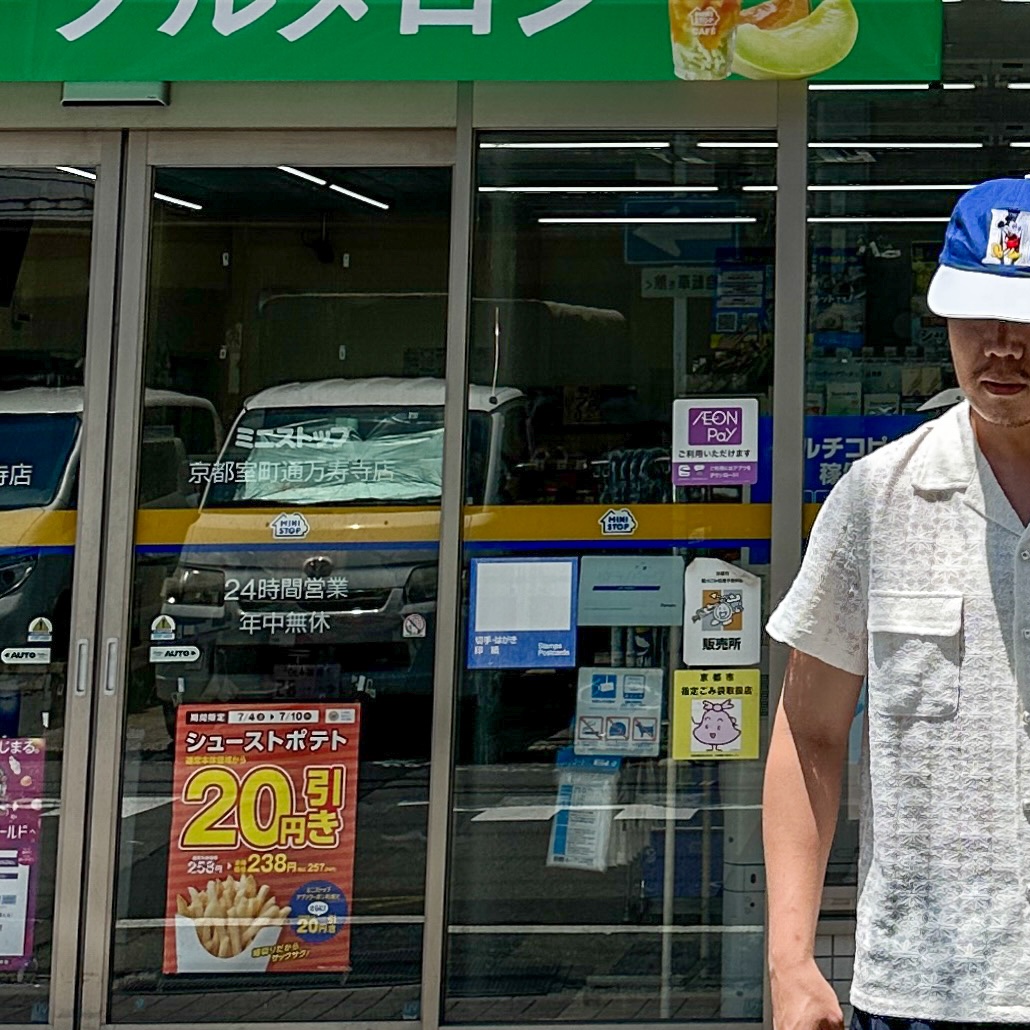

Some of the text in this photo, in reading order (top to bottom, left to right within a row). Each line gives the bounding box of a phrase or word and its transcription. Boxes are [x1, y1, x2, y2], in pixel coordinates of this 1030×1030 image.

[235, 426, 350, 448] ミニストップ
[678, 449, 751, 458] ご利用いただけます
[188, 461, 394, 484] 京都室町通万寿寺店
[608, 516, 628, 524] MINI
[279, 527, 301, 535] STOP
[224, 577, 349, 600] 24時間営業
[239, 611, 330, 634] 年中無休
[702, 638, 742, 651] 販売所
[11, 651, 36, 659] AUTO
[164, 649, 190, 658] AUTO
[700, 672, 734, 682] 京都市
[681, 686, 753, 696] 指定ごみ袋取扱店
[190, 713, 226, 722] 期間限定
[186, 728, 348, 752] シューストポテト
